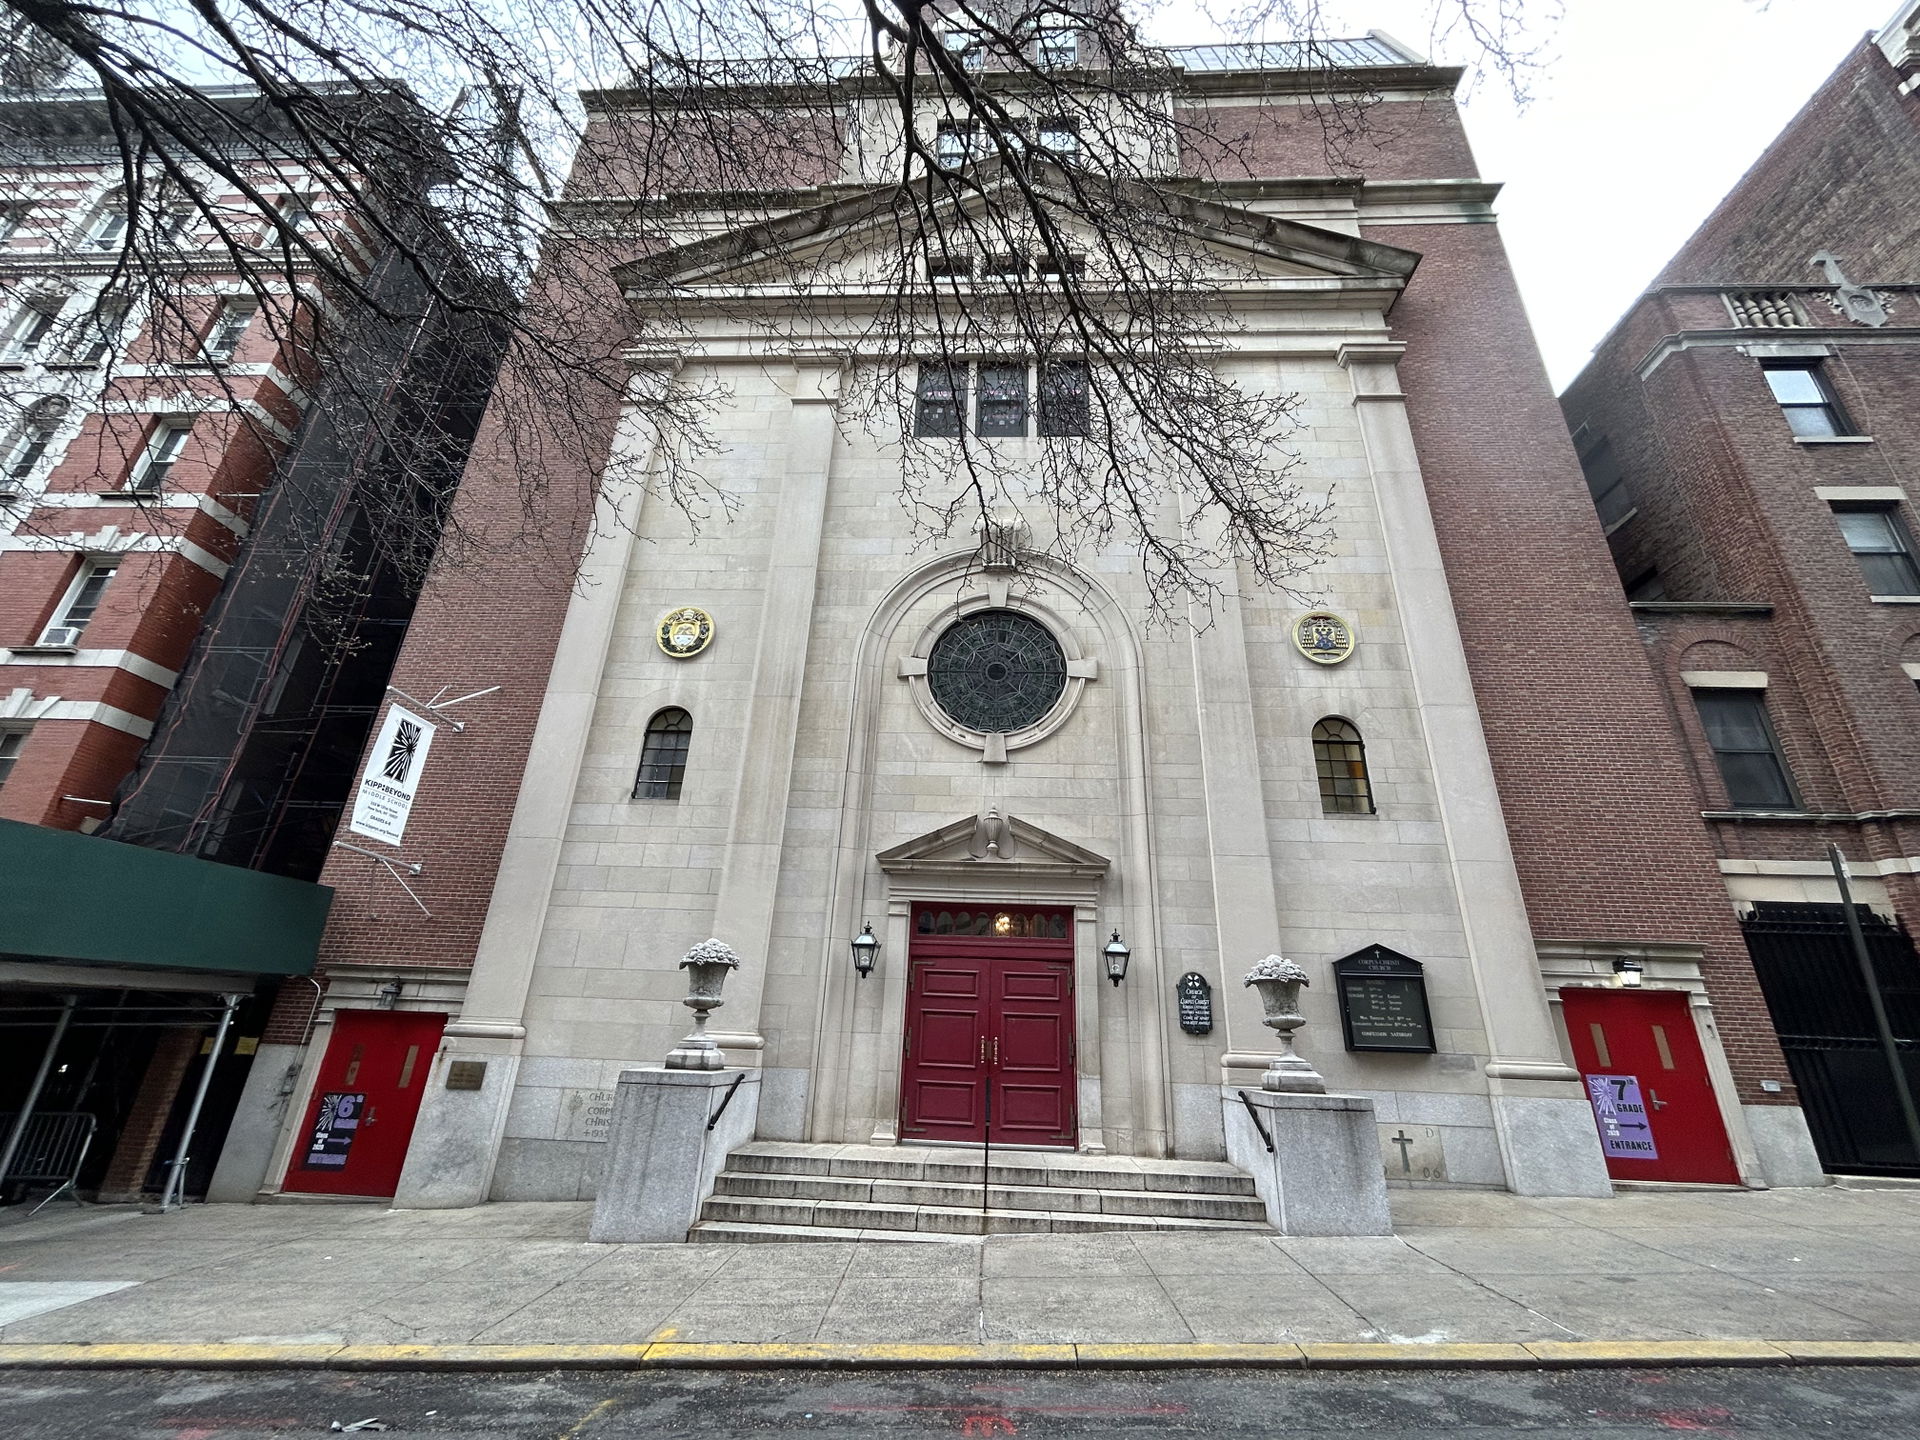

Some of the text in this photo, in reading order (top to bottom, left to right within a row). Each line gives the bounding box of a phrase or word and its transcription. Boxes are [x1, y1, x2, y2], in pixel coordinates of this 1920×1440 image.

[362, 789, 386, 800] MIDDLE
[387, 797, 409, 809] SCHOOL
[1616, 1103, 1644, 1113] GRADE
[1425, 1127, 1435, 1138] D
[1610, 1140, 1653, 1151] ENTRANCE
